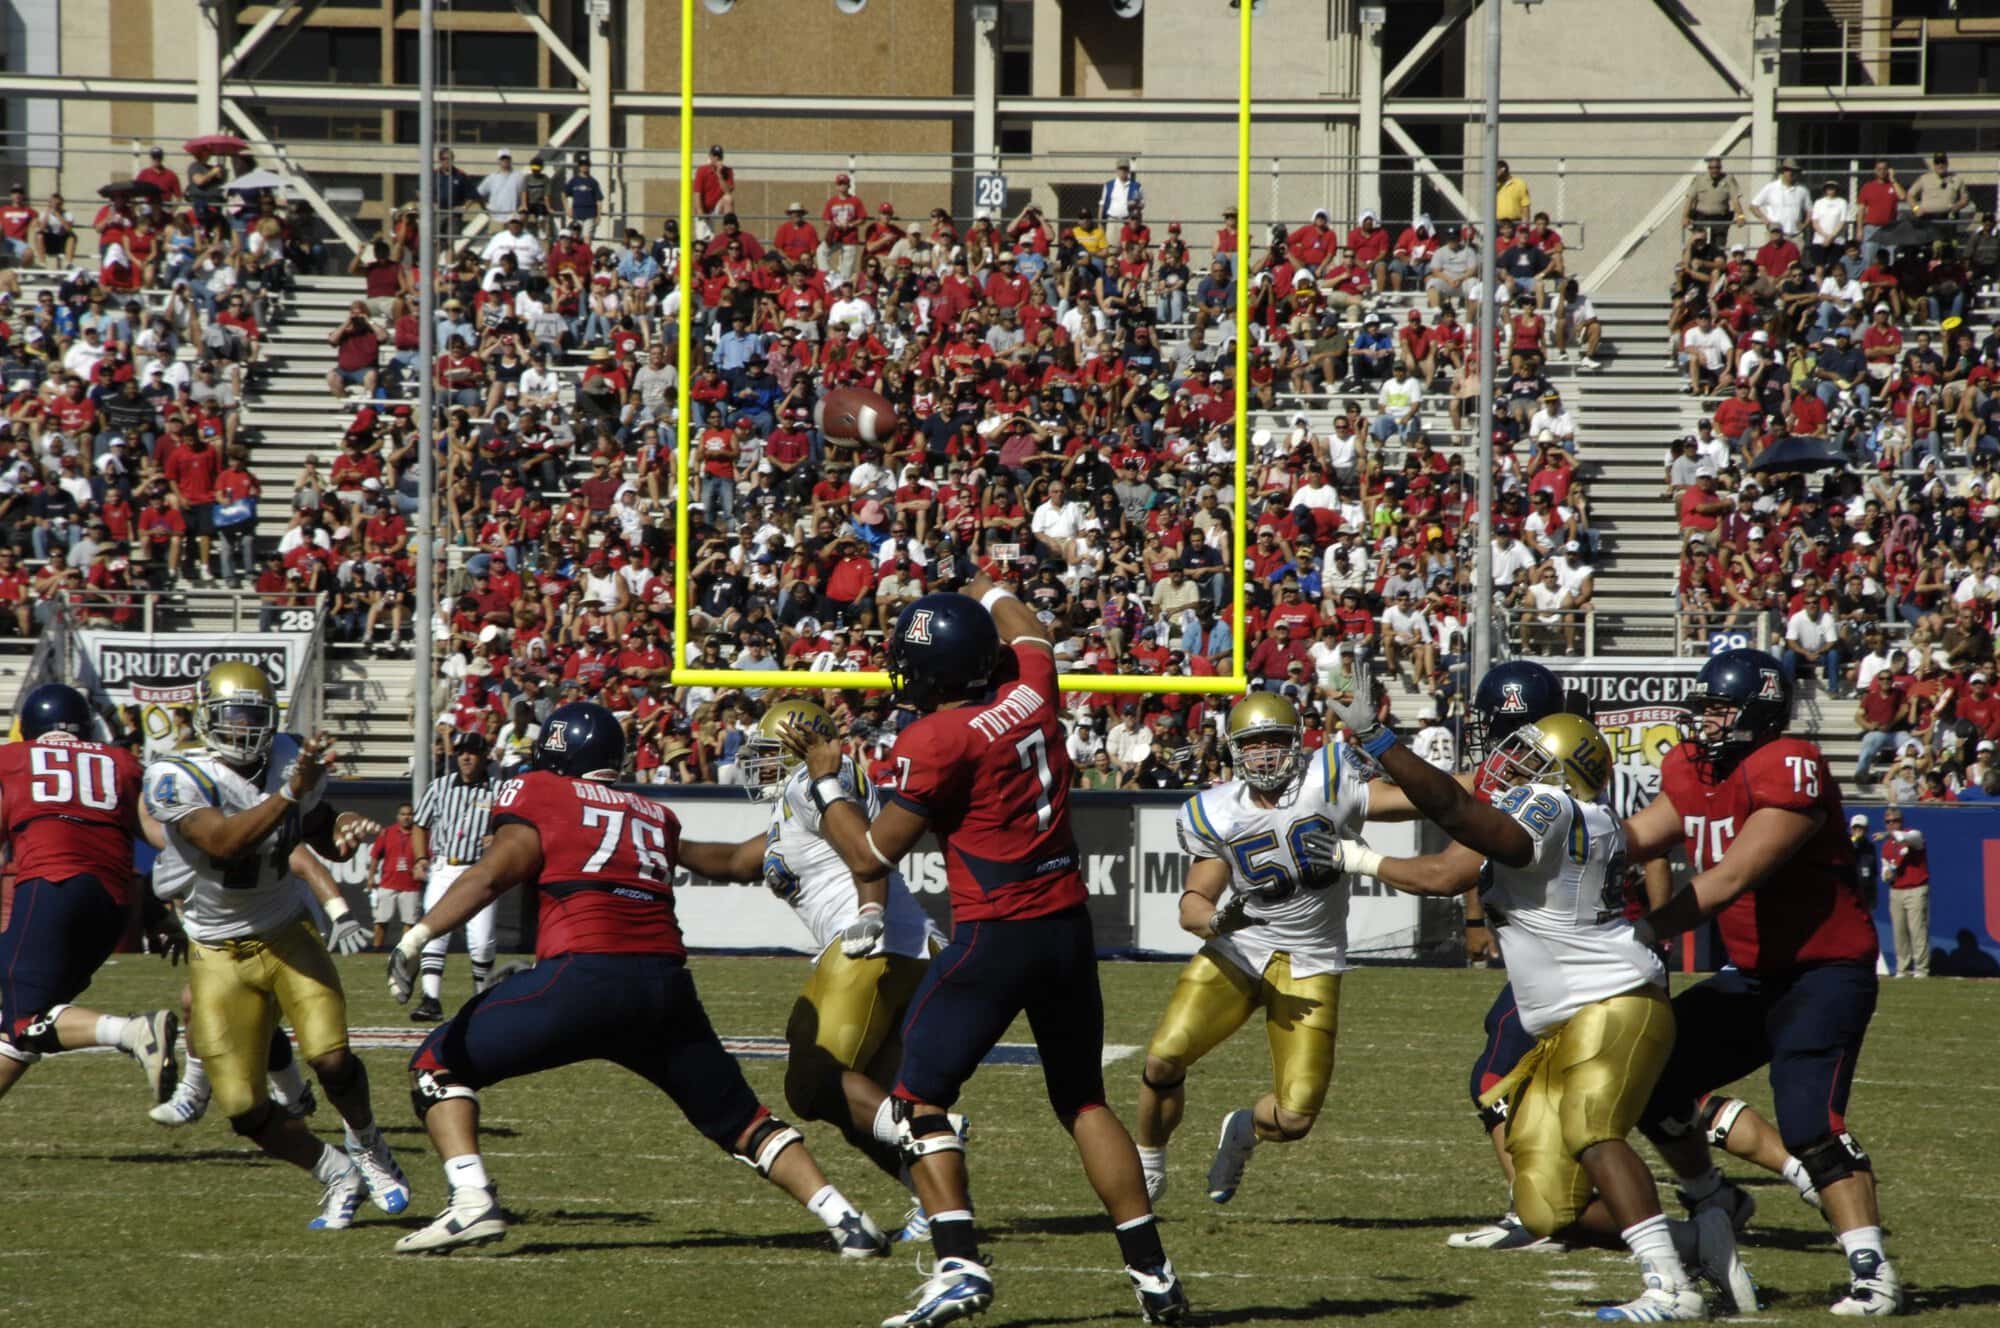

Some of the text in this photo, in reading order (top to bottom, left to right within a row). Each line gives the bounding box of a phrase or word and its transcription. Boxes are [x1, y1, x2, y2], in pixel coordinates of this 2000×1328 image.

[979, 178, 1003, 205] 28
[280, 610, 315, 631] 28
[1711, 634, 1747, 655] 29
[140, 688, 193, 701] BAKED
[968, 684, 1045, 742] TUITAMA
[1598, 713, 1629, 726] KED
[30, 747, 118, 811] 50
[897, 756, 912, 791] 7
[1015, 728, 1053, 832] 7
[1785, 756, 1818, 798] 75
[581, 805, 672, 884] 76
